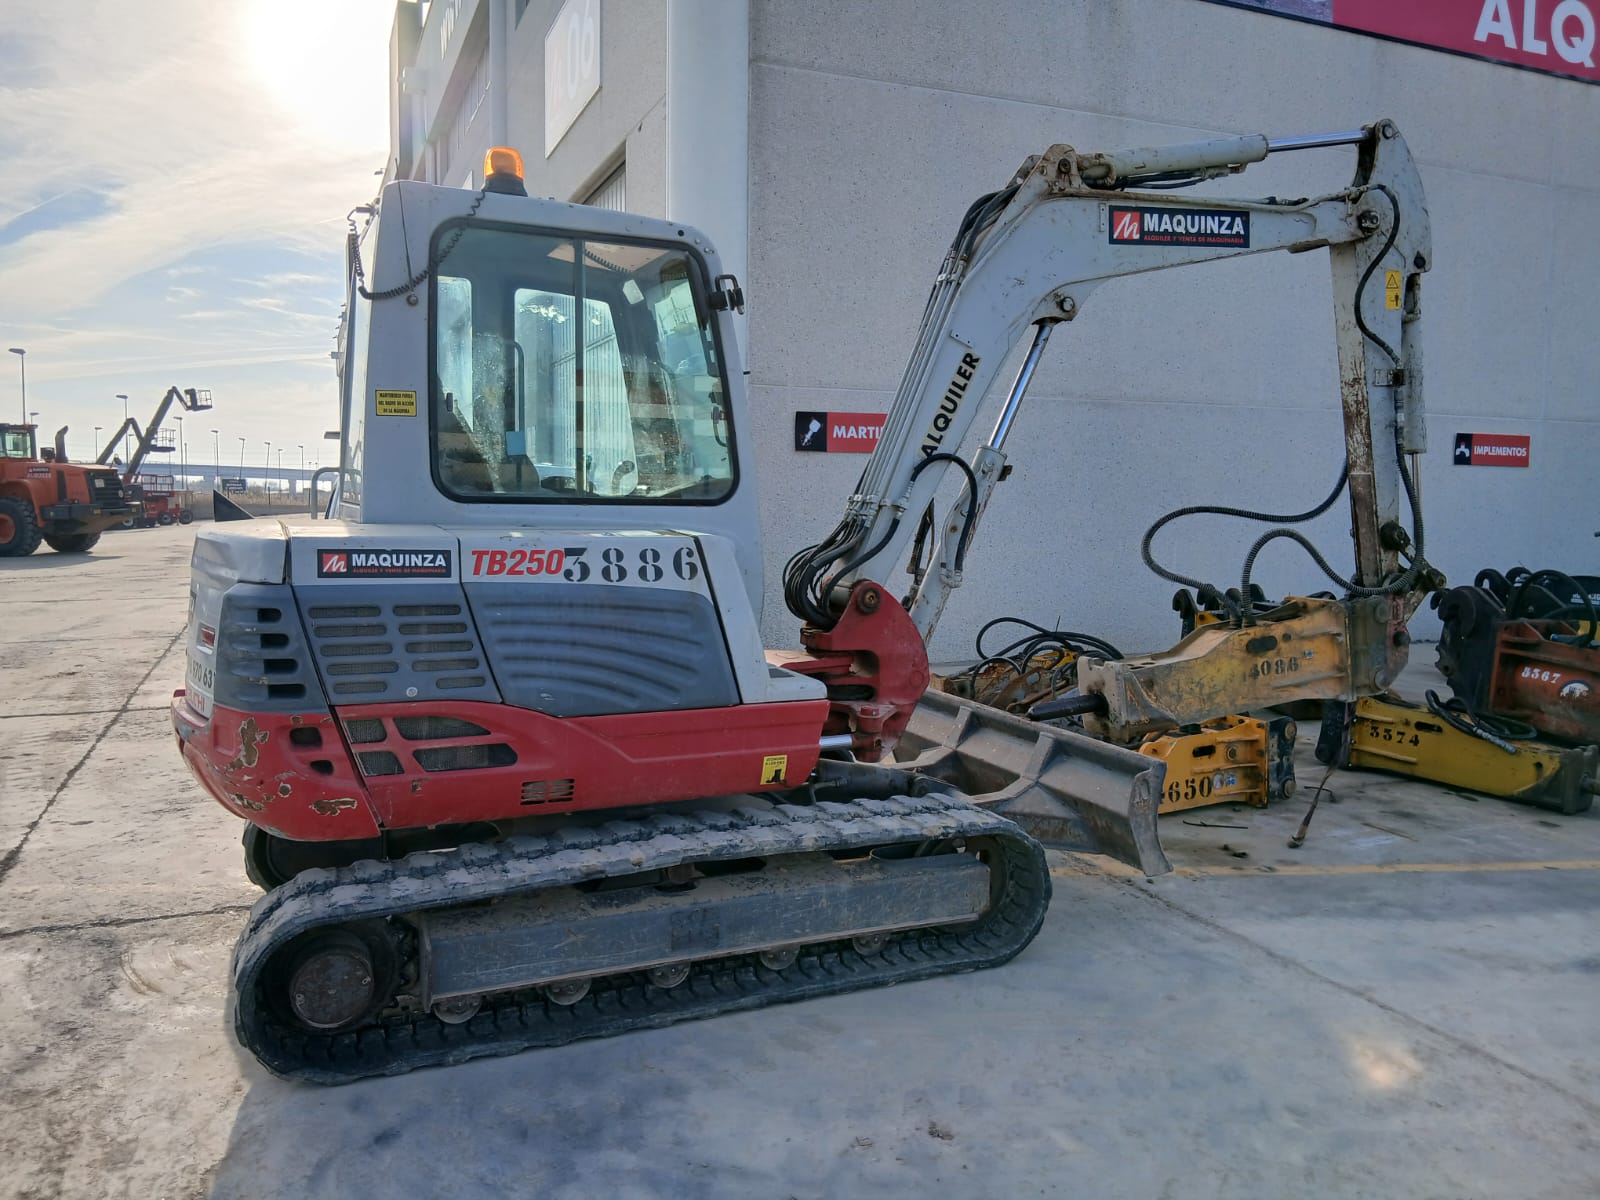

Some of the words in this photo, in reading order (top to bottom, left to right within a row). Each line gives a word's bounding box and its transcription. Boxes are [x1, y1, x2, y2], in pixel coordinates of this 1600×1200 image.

[1474, 0, 1596, 67] ALQ
[1144, 213, 1245, 235] MAQUINZA
[921, 352, 981, 460] ALQUILER
[1474, 445, 1527, 457] IMPLEMENTOS
[352, 553, 446, 567] MAQUINZA
[471, 549, 564, 575] TB250
[563, 547, 699, 582] 3886
[1160, 775, 1213, 803] 650
